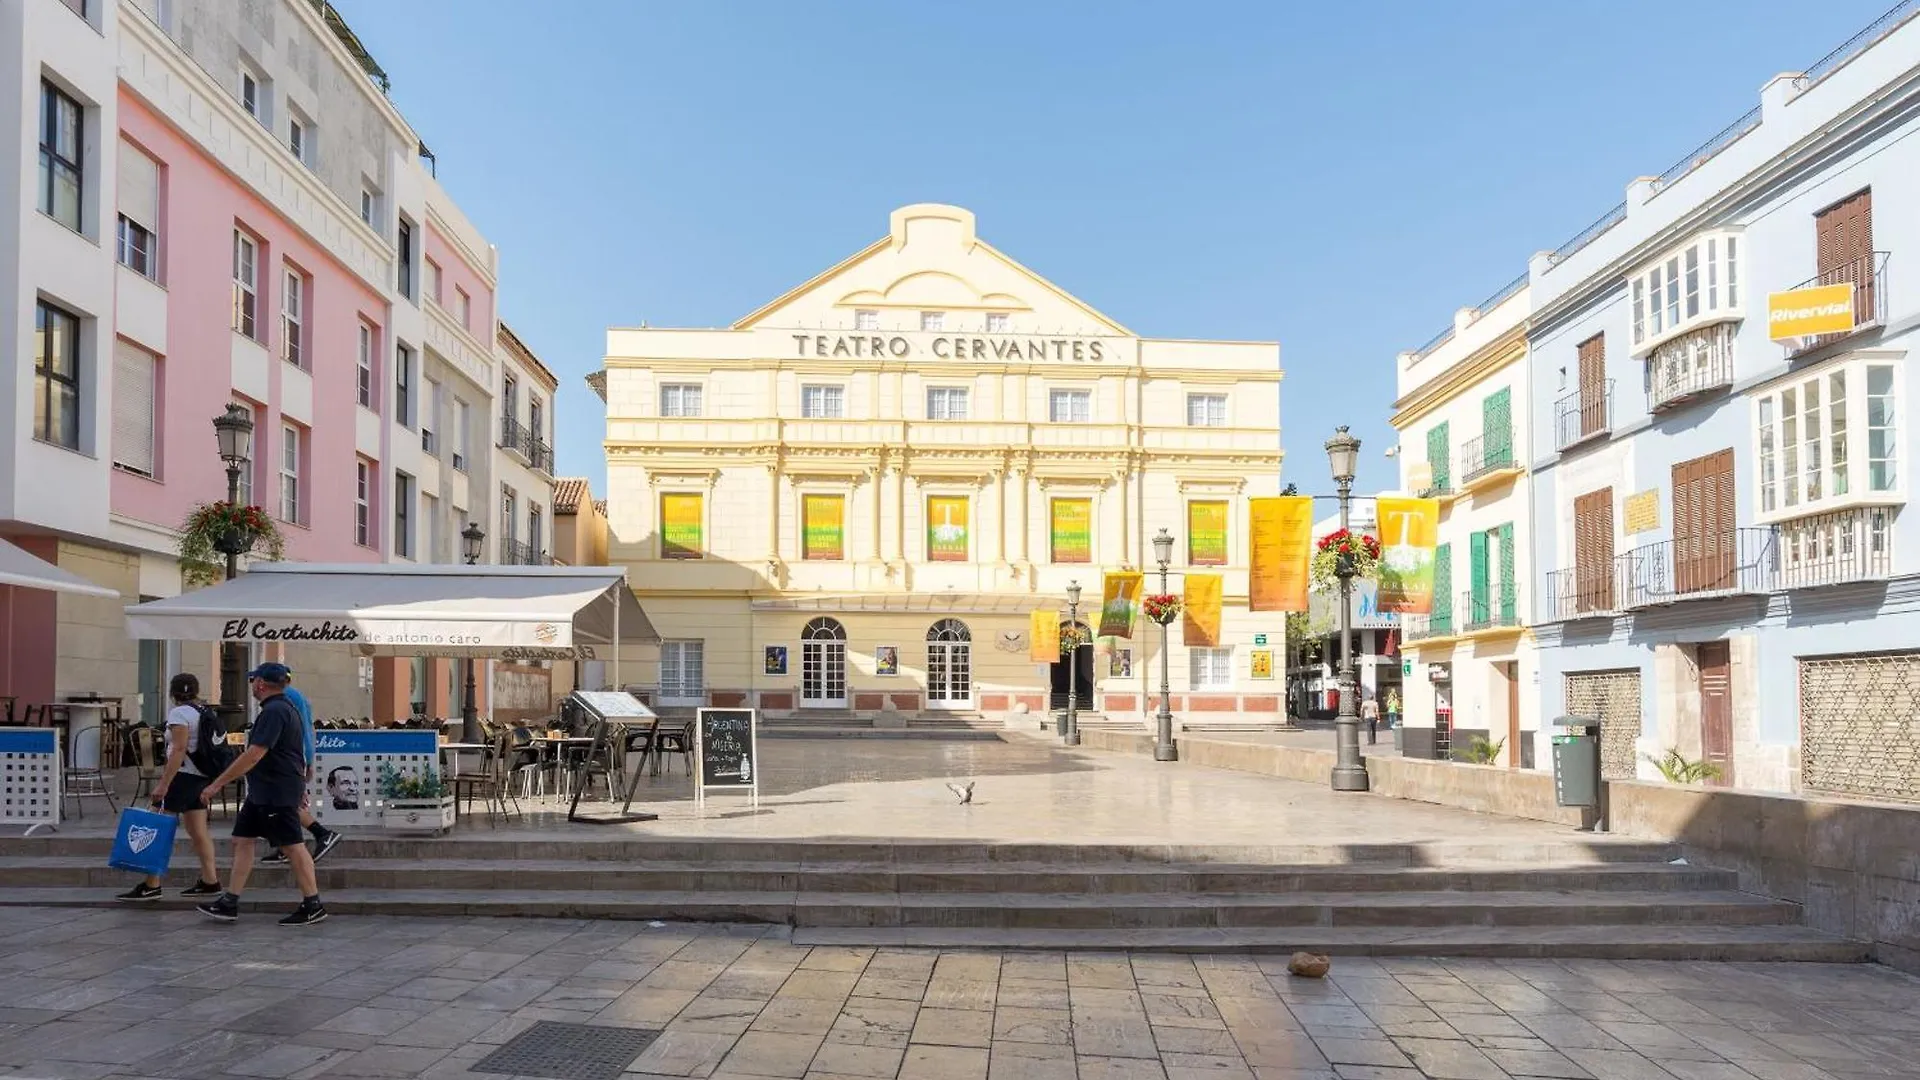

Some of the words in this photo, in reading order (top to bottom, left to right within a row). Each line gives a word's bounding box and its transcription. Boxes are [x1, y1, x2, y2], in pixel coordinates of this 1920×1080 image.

[1770, 301, 1850, 322] Rivervial
[792, 335, 910, 357] TEATRO
[932, 337, 1105, 361] CERVANTES
[222, 618, 248, 639] El
[251, 621, 359, 641] Cartuchito
[364, 631, 381, 643] de
[387, 632, 443, 644] antonio
[449, 634, 481, 645] caro
